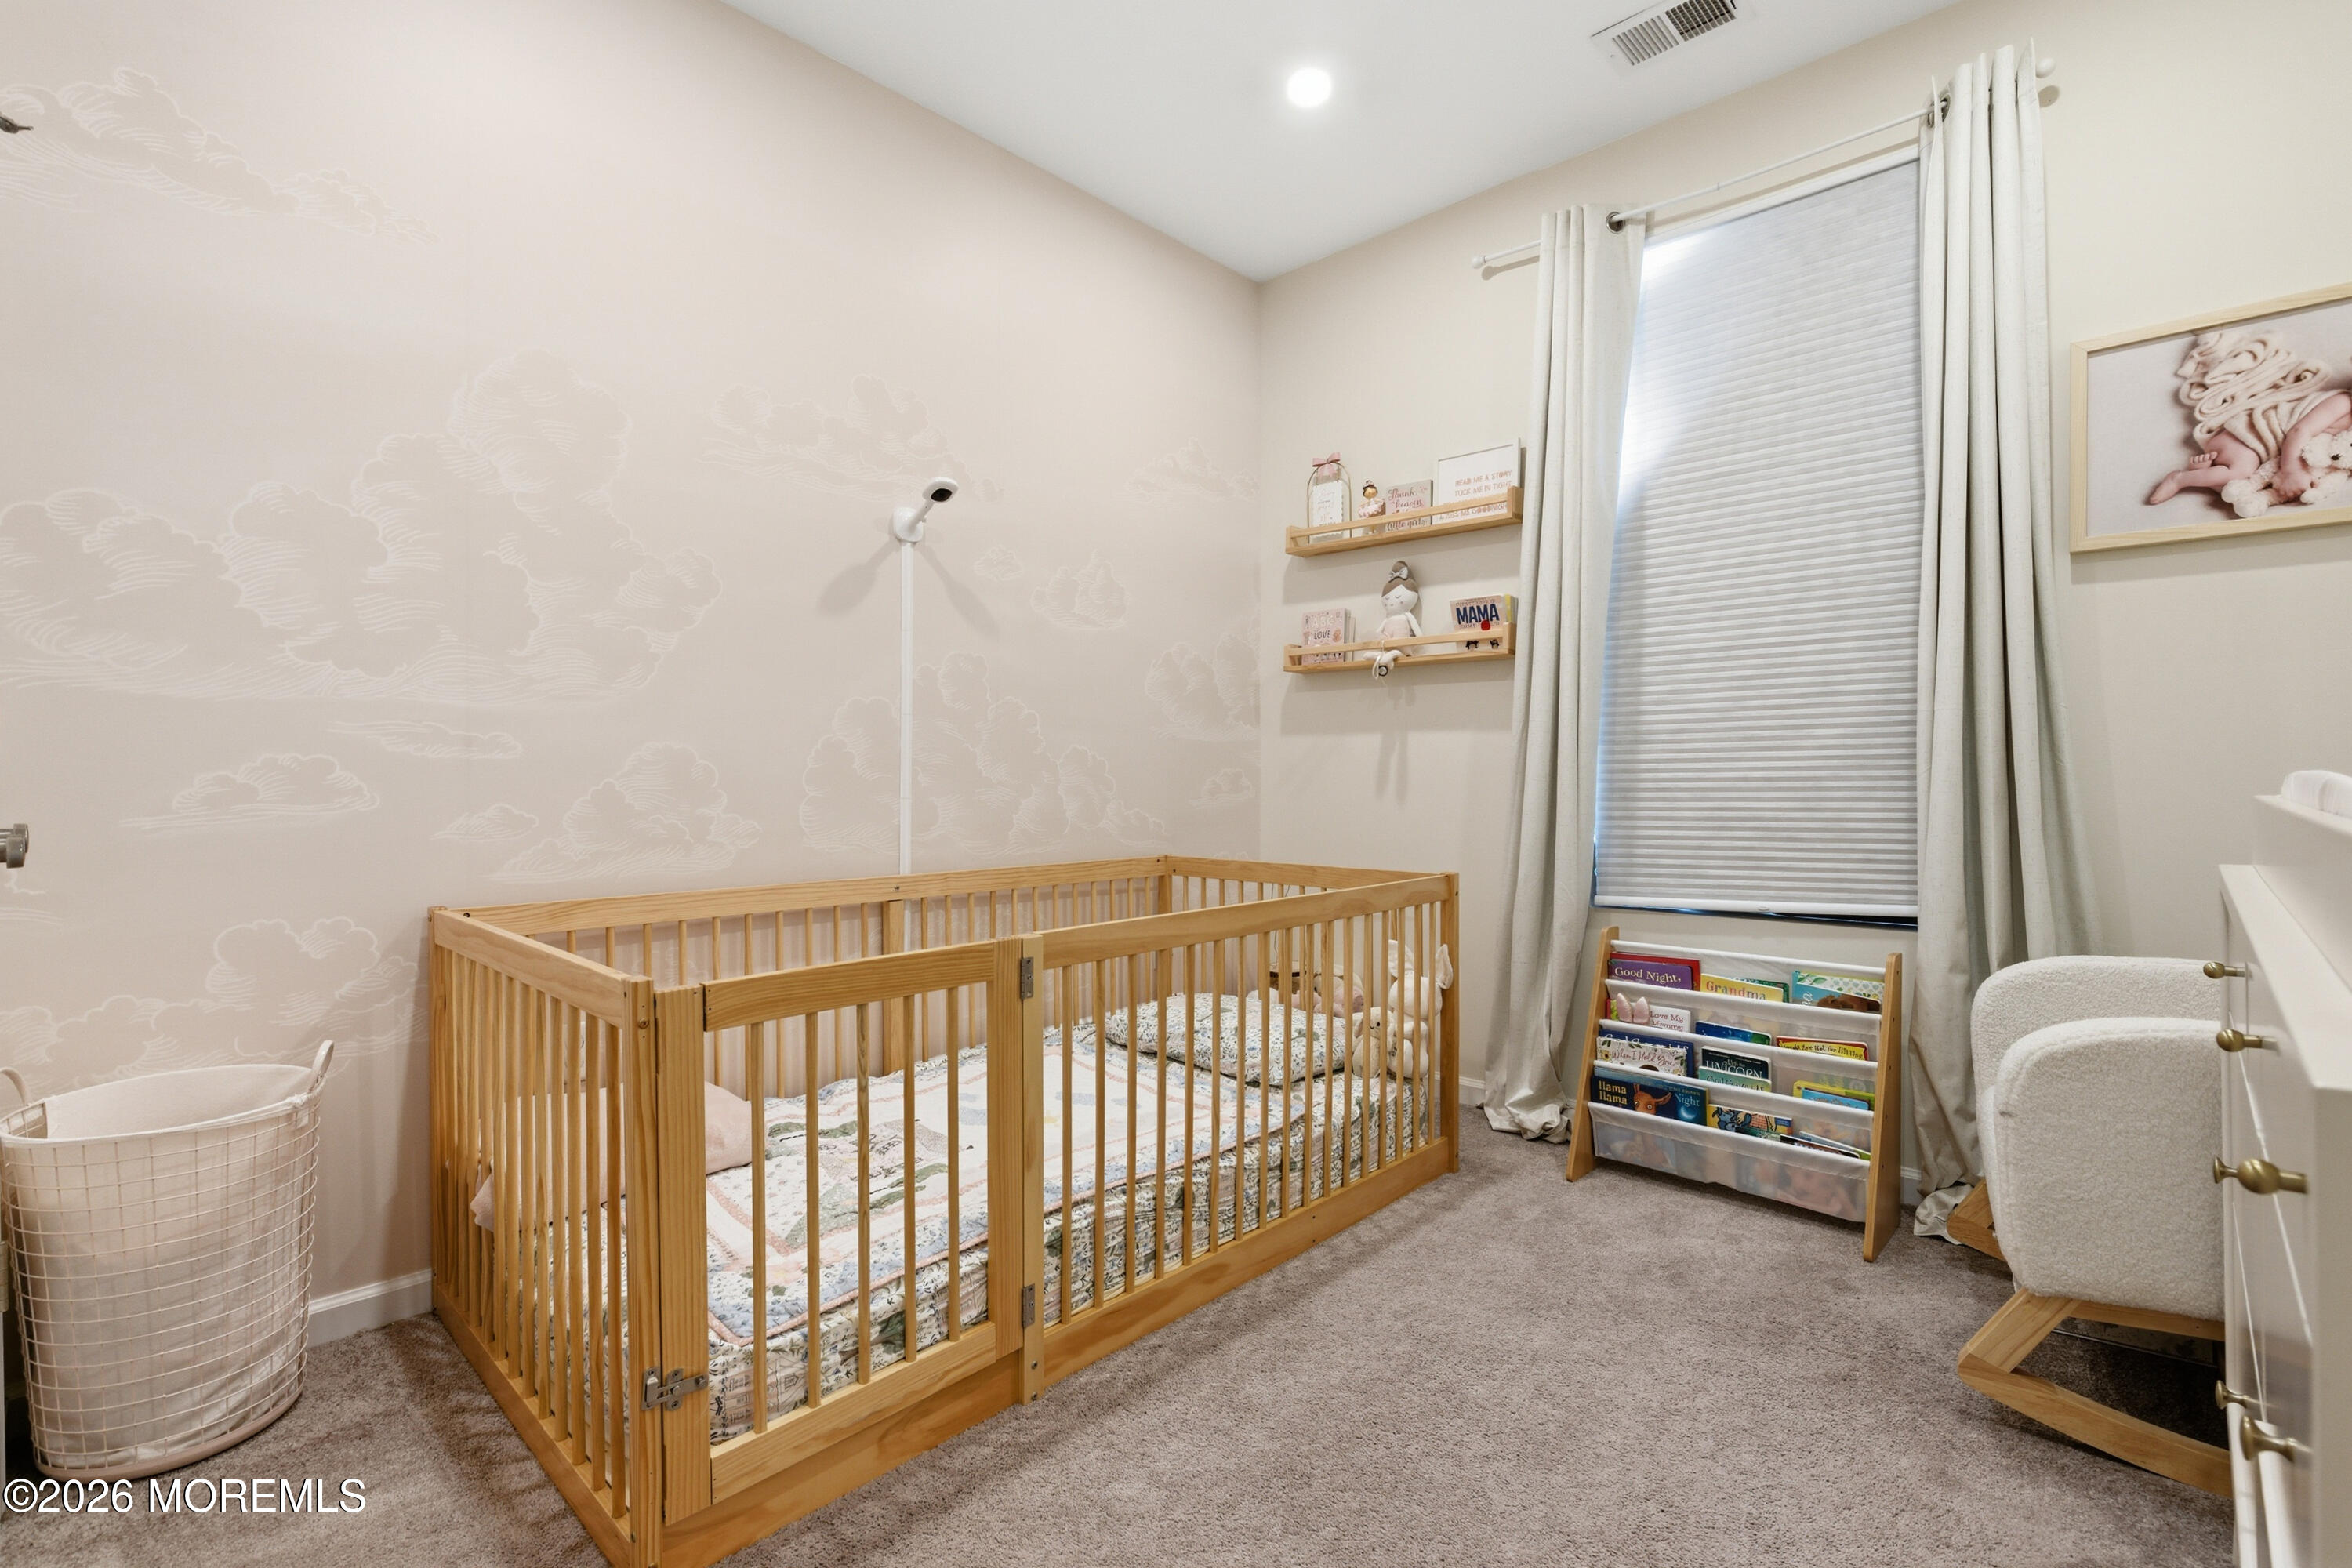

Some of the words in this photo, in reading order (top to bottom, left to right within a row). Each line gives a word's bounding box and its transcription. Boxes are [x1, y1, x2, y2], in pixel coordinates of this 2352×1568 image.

[1473, 475, 1483, 484] ME
[1388, 487, 1417, 501] Thank
[1456, 603, 1500, 625] MAMA
[1314, 630, 1330, 640] LOVE
[1614, 967, 1643, 978] Good
[1646, 971, 1682, 985] Night,
[1706, 981, 1766, 1000] Grandma
[1650, 1011, 1668, 1020] Love
[1670, 1014, 1684, 1024] My
[1611, 1047, 1632, 1059] When
[1632, 1050, 1637, 1061] I
[1638, 1051, 1657, 1063] Hold
[1599, 1080, 1627, 1094] llama
[1599, 1090, 1628, 1105] llama
